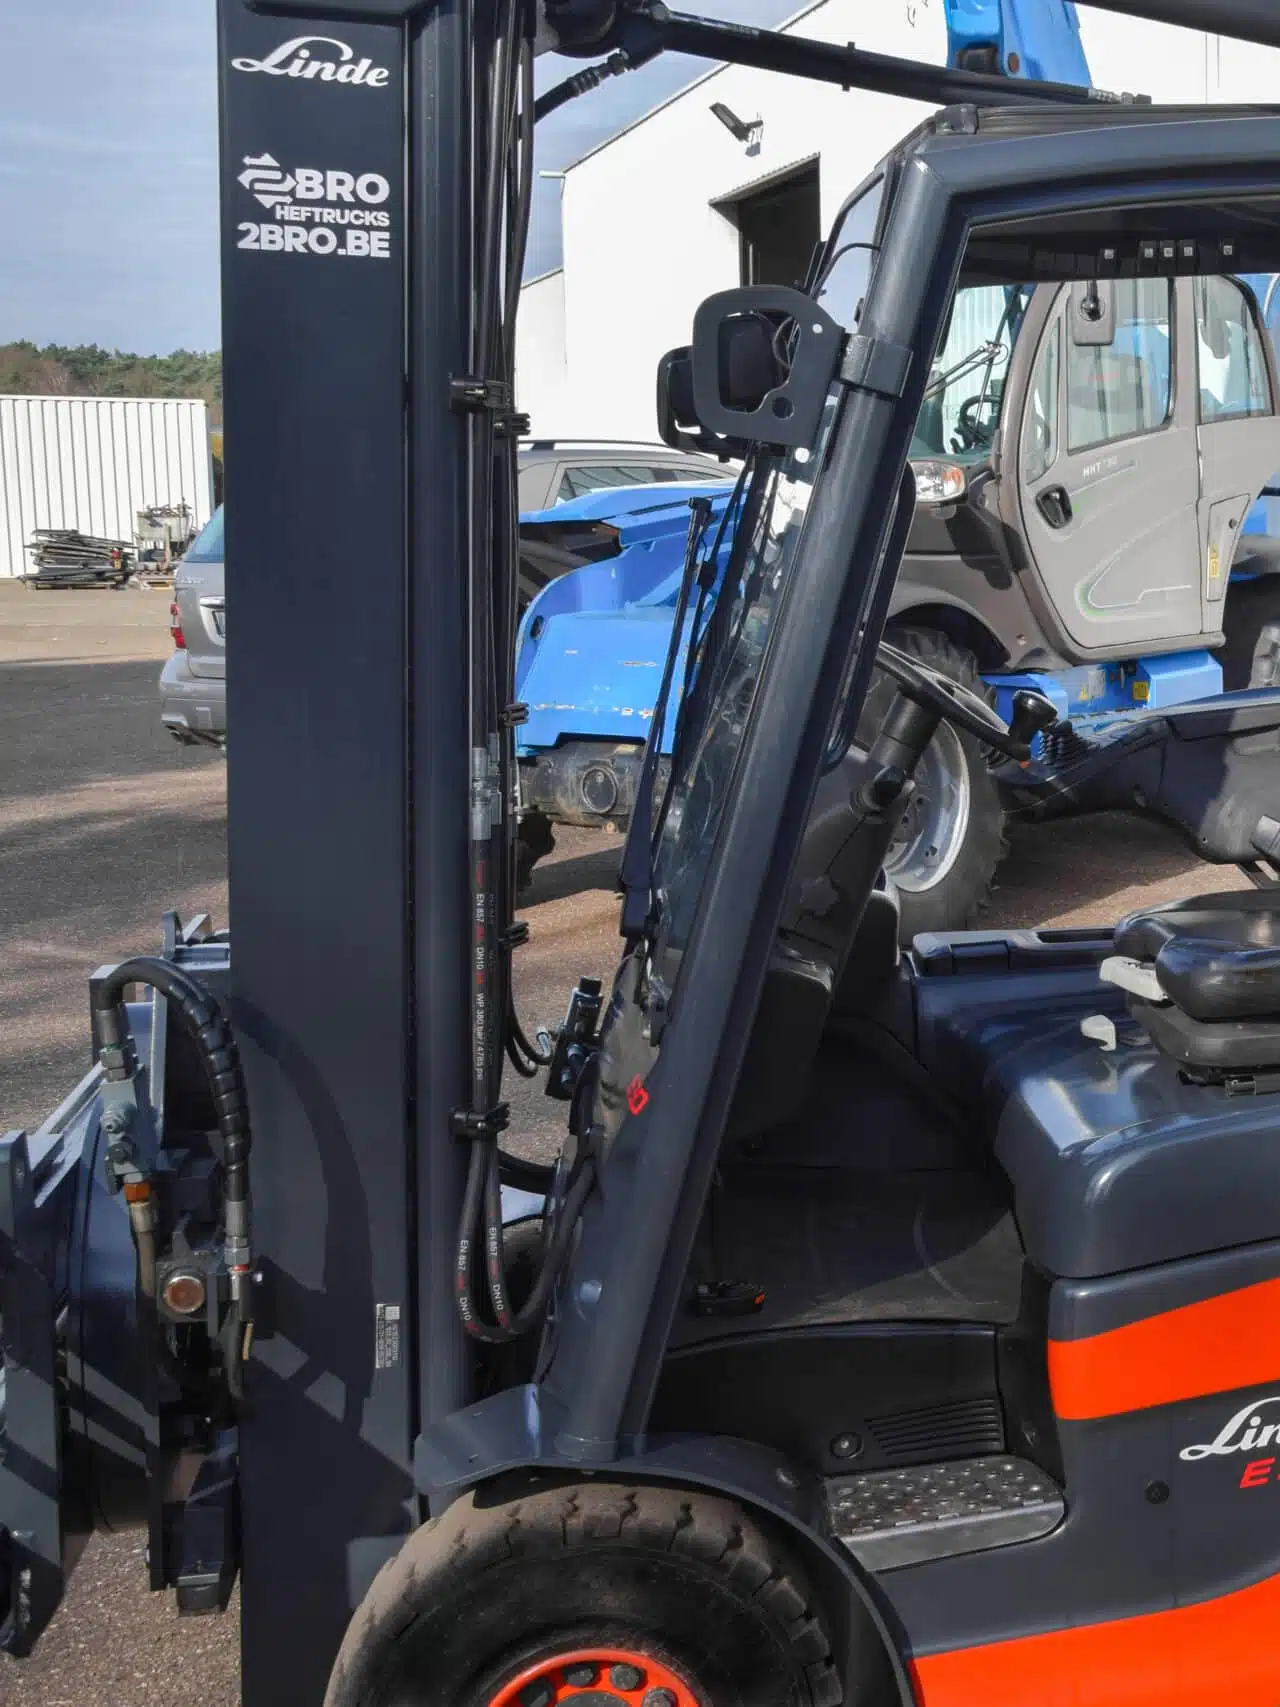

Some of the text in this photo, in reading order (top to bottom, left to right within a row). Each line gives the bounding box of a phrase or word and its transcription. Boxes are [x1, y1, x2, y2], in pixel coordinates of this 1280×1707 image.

[231, 35, 390, 88] Linde
[275, 205, 391, 227] HEFTRUCKS
[237, 222, 391, 258] 2BRO.BE
[1239, 1456, 1276, 1489] E
